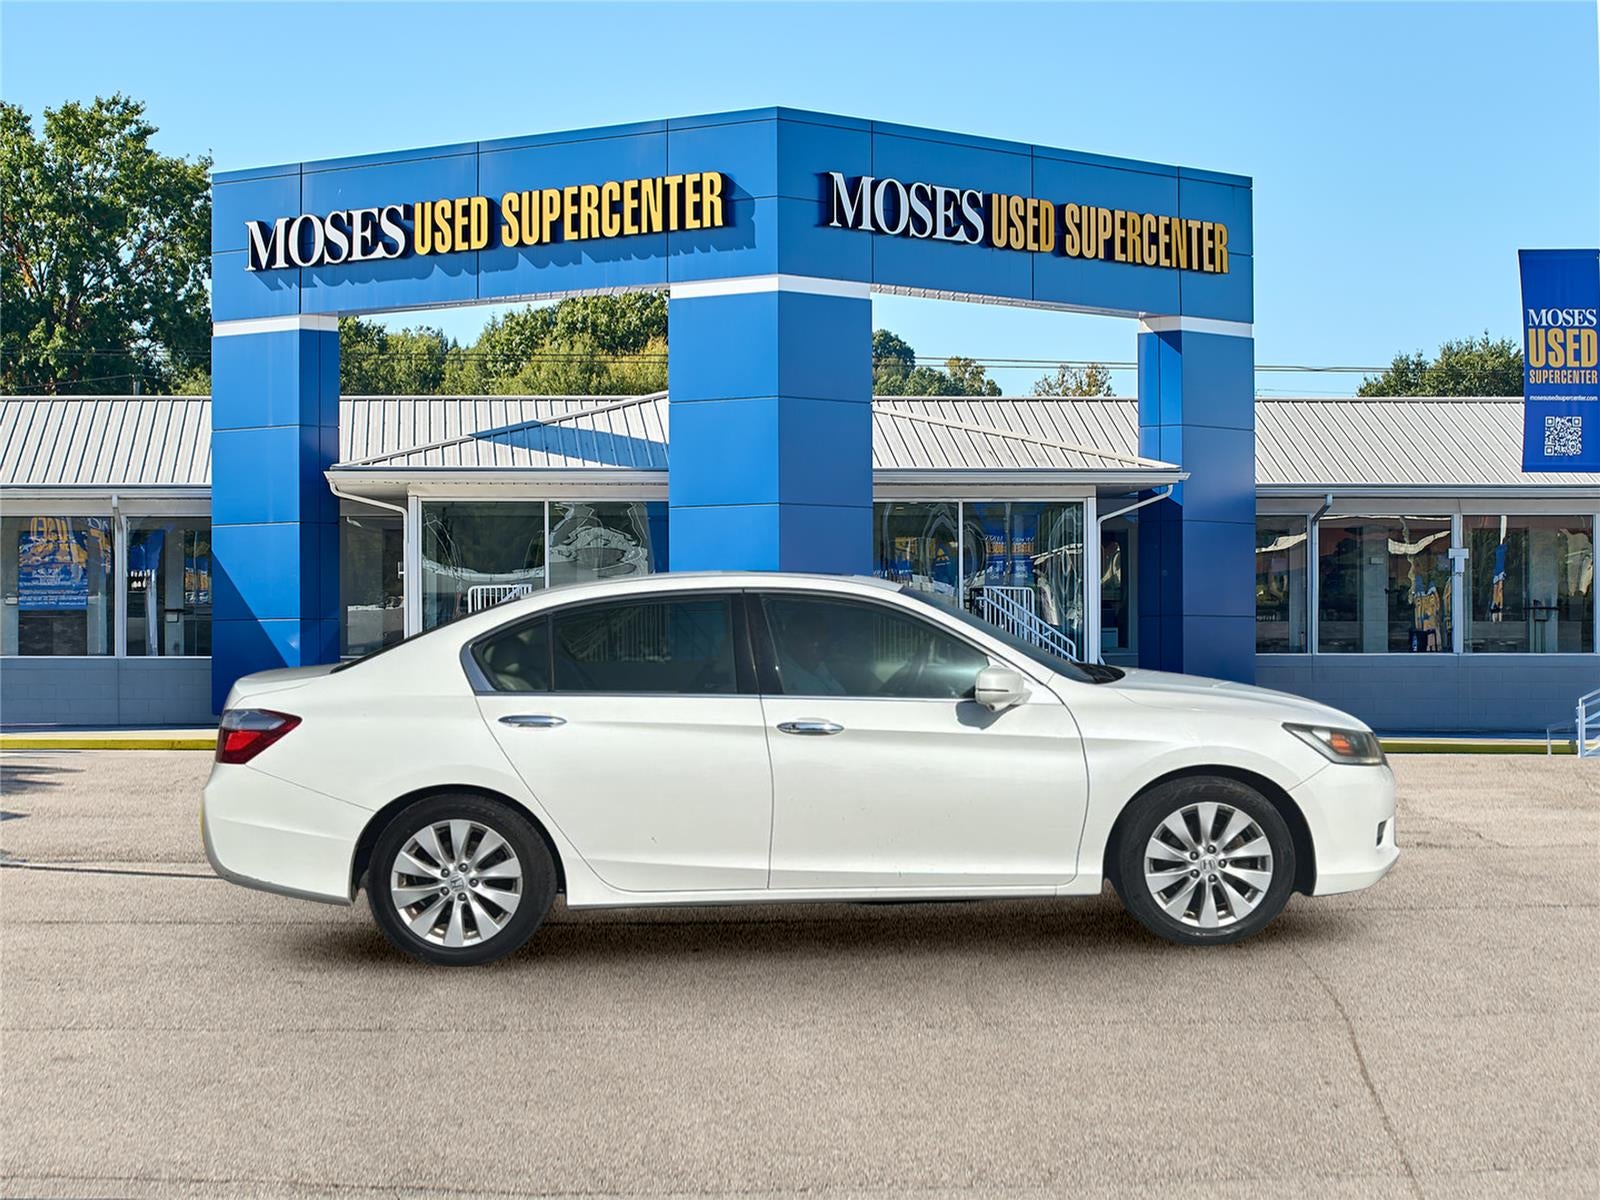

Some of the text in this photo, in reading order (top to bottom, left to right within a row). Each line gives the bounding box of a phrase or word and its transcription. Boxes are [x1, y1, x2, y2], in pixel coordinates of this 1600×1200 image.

[245, 171, 723, 271] MOSES USED SUPERCENTER
[829, 172, 1229, 273] MOSES USED SUPERCENTER
[1528, 308, 1597, 327] MOSES
[1528, 328, 1598, 368] USED
[1529, 369, 1598, 384] SUPERCENTER
